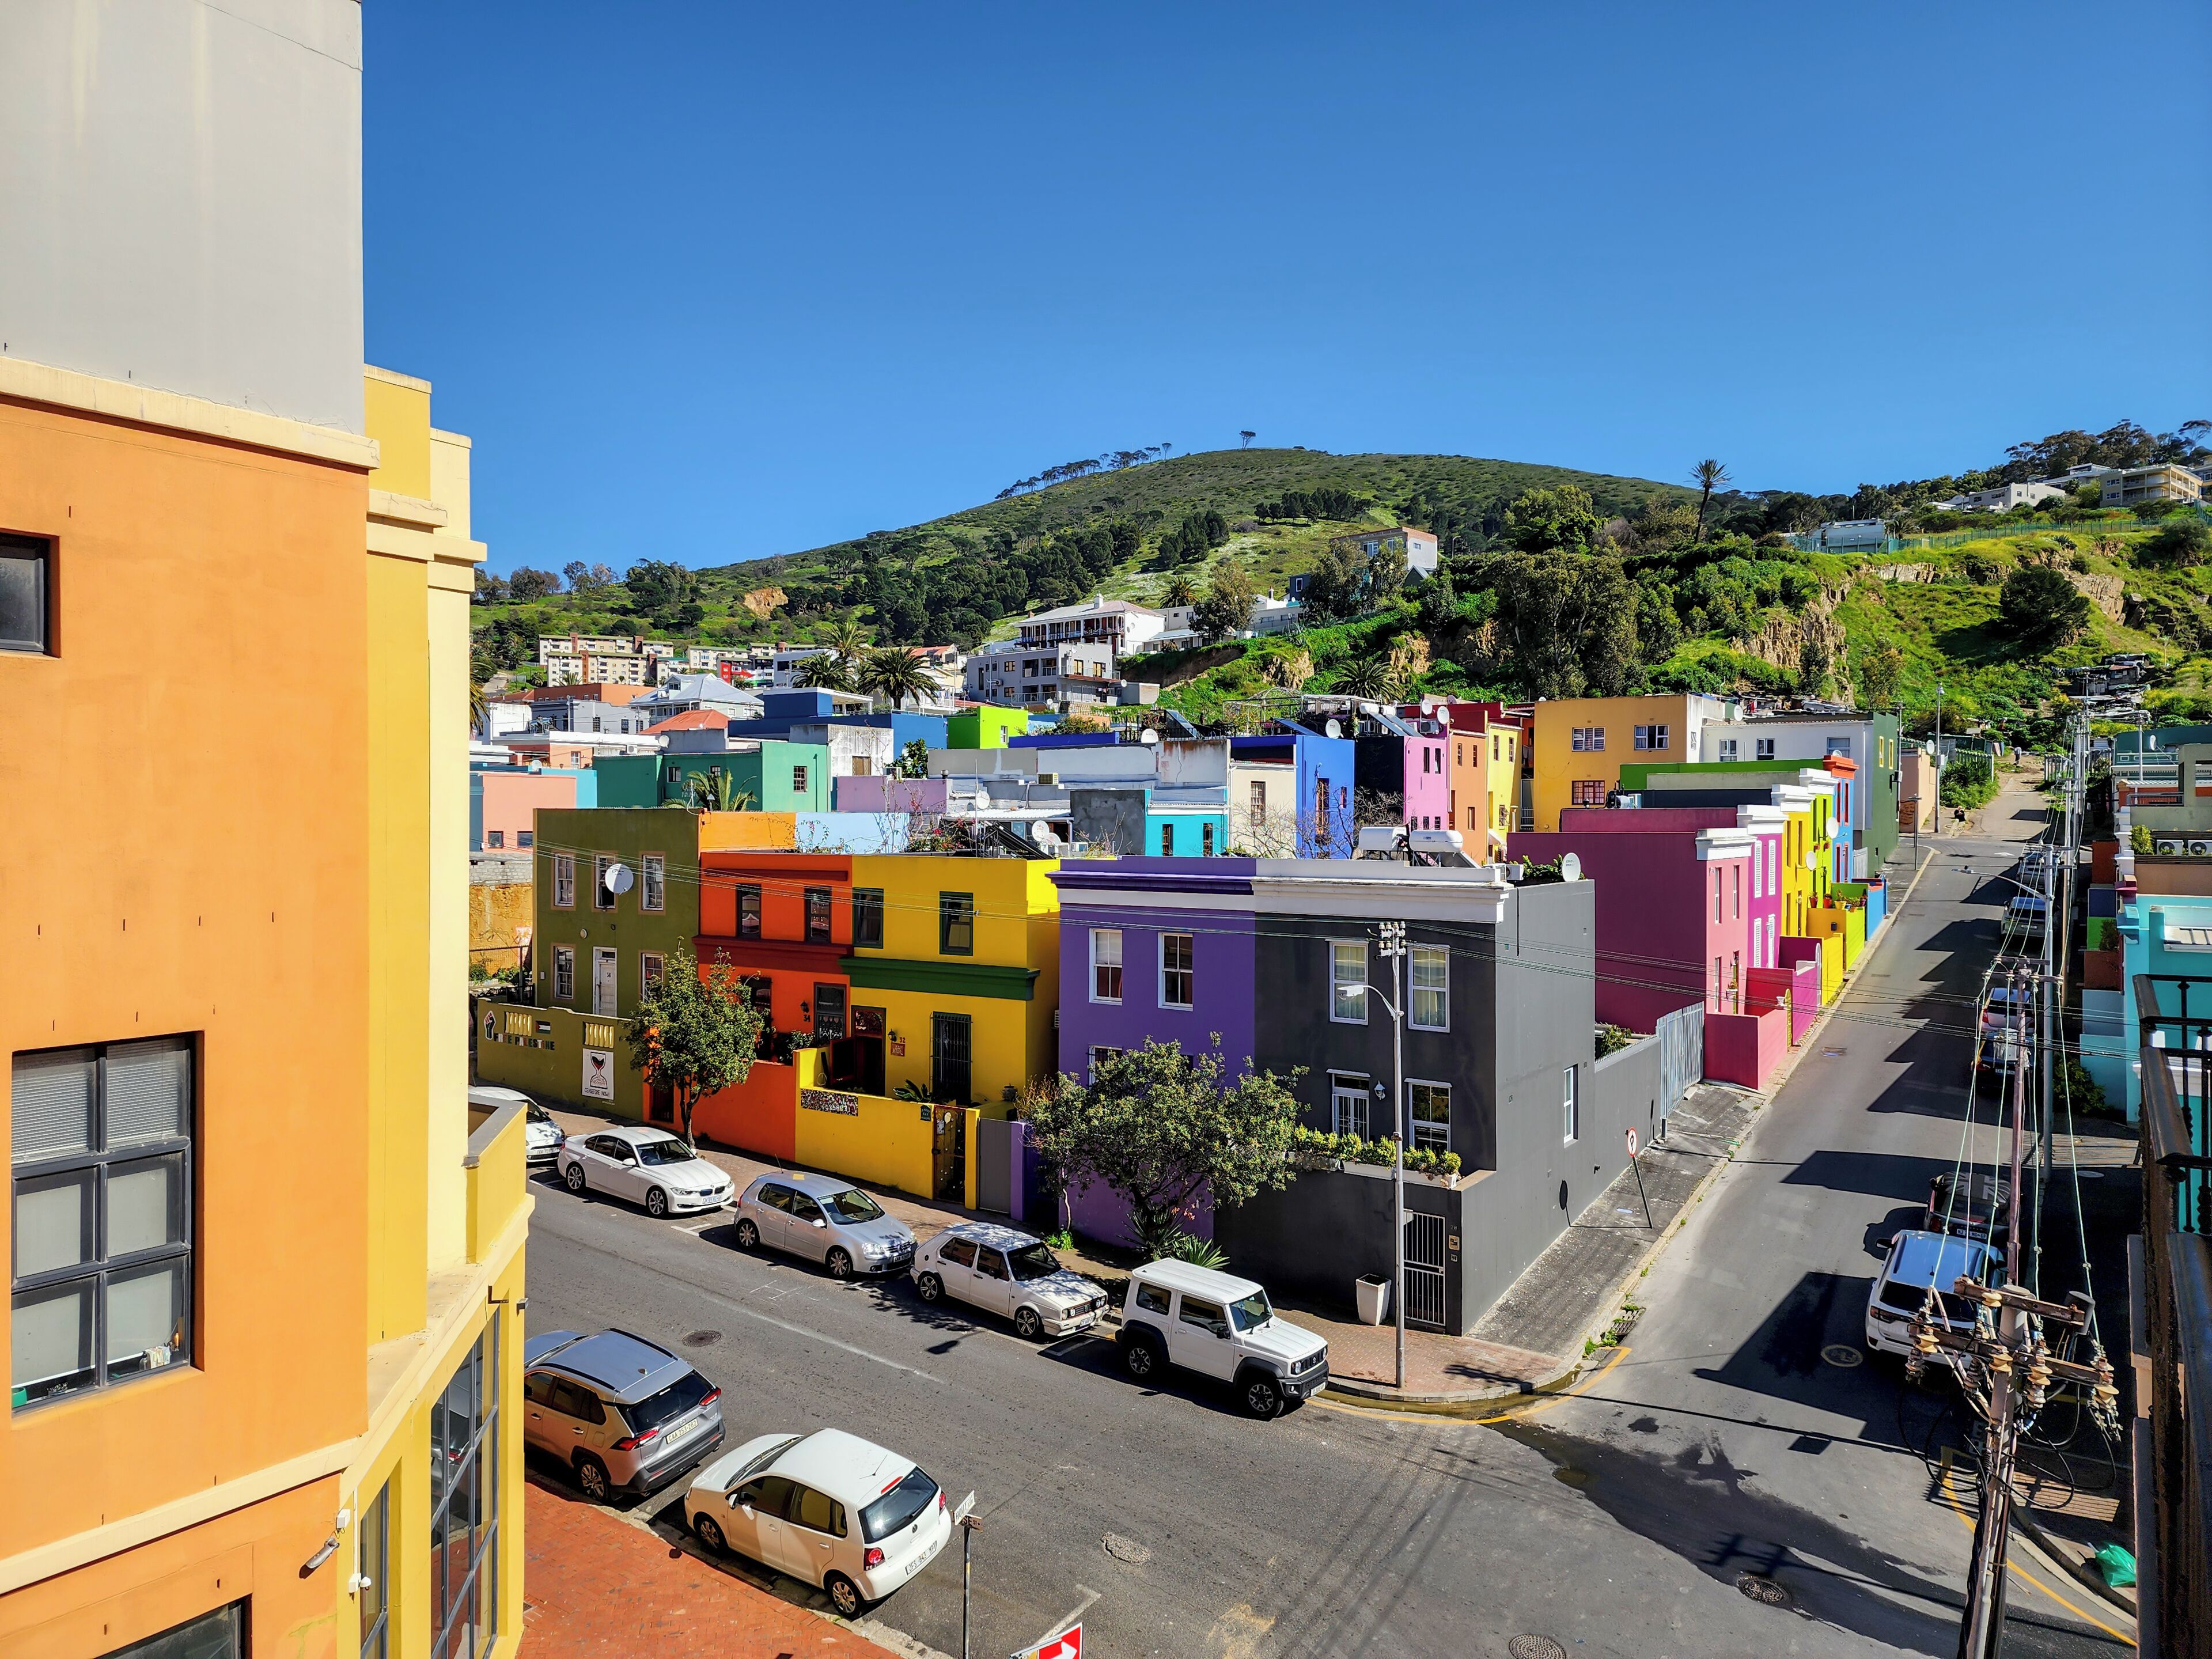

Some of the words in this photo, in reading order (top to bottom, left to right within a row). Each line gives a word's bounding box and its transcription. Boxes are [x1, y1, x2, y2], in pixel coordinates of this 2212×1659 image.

[804, 1014, 810, 1022] 34
[494, 1033, 512, 1044] FREE
[514, 1036, 555, 1050] PALESTINE
[668, 1433, 678, 1441] CAA
[679, 1420, 697, 1434] 253-282
[956, 1502, 967, 1521] HOUT
[909, 1560, 917, 1571] JFS
[918, 1552, 927, 1563] 343
